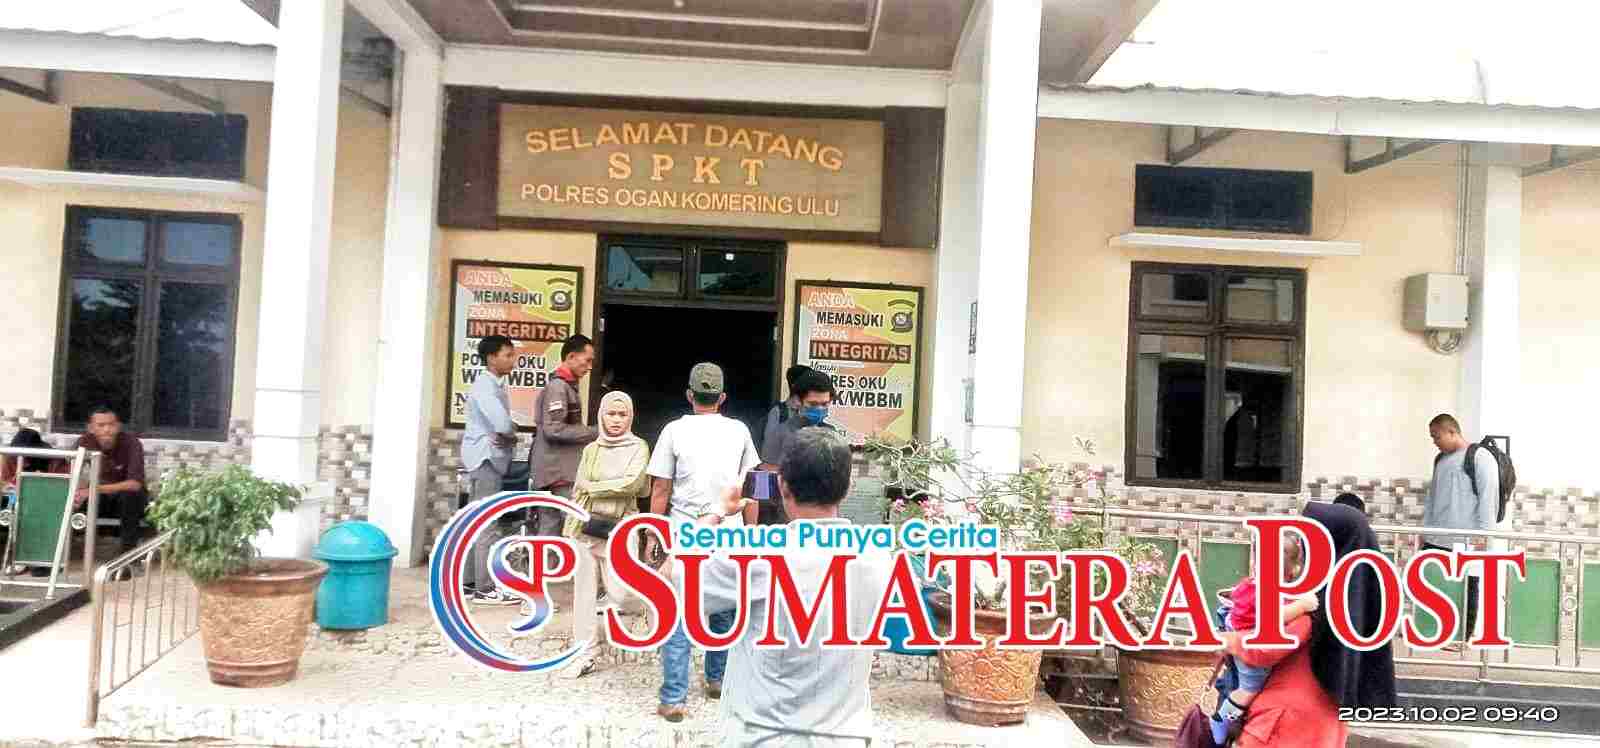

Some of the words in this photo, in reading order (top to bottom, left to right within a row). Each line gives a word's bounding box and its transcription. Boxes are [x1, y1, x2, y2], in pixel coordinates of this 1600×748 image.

[525, 121, 696, 154] SELAMAT
[704, 123, 844, 171] DATANG
[520, 183, 609, 205] POLRES
[615, 187, 681, 209] OGAN
[682, 190, 794, 215] KOMERING
[797, 196, 840, 217] ULU
[463, 271, 513, 287] ANDA
[473, 291, 543, 306] MEMASUKI
[808, 291, 856, 308] ANDA
[816, 311, 884, 328] MEMASUKI
[469, 320, 568, 341] INTEGRITAS
[810, 328, 849, 340] ZONA
[811, 342, 910, 362] INTEGRITAS
[517, 356, 547, 370] OKU
[858, 376, 887, 390] OKU
